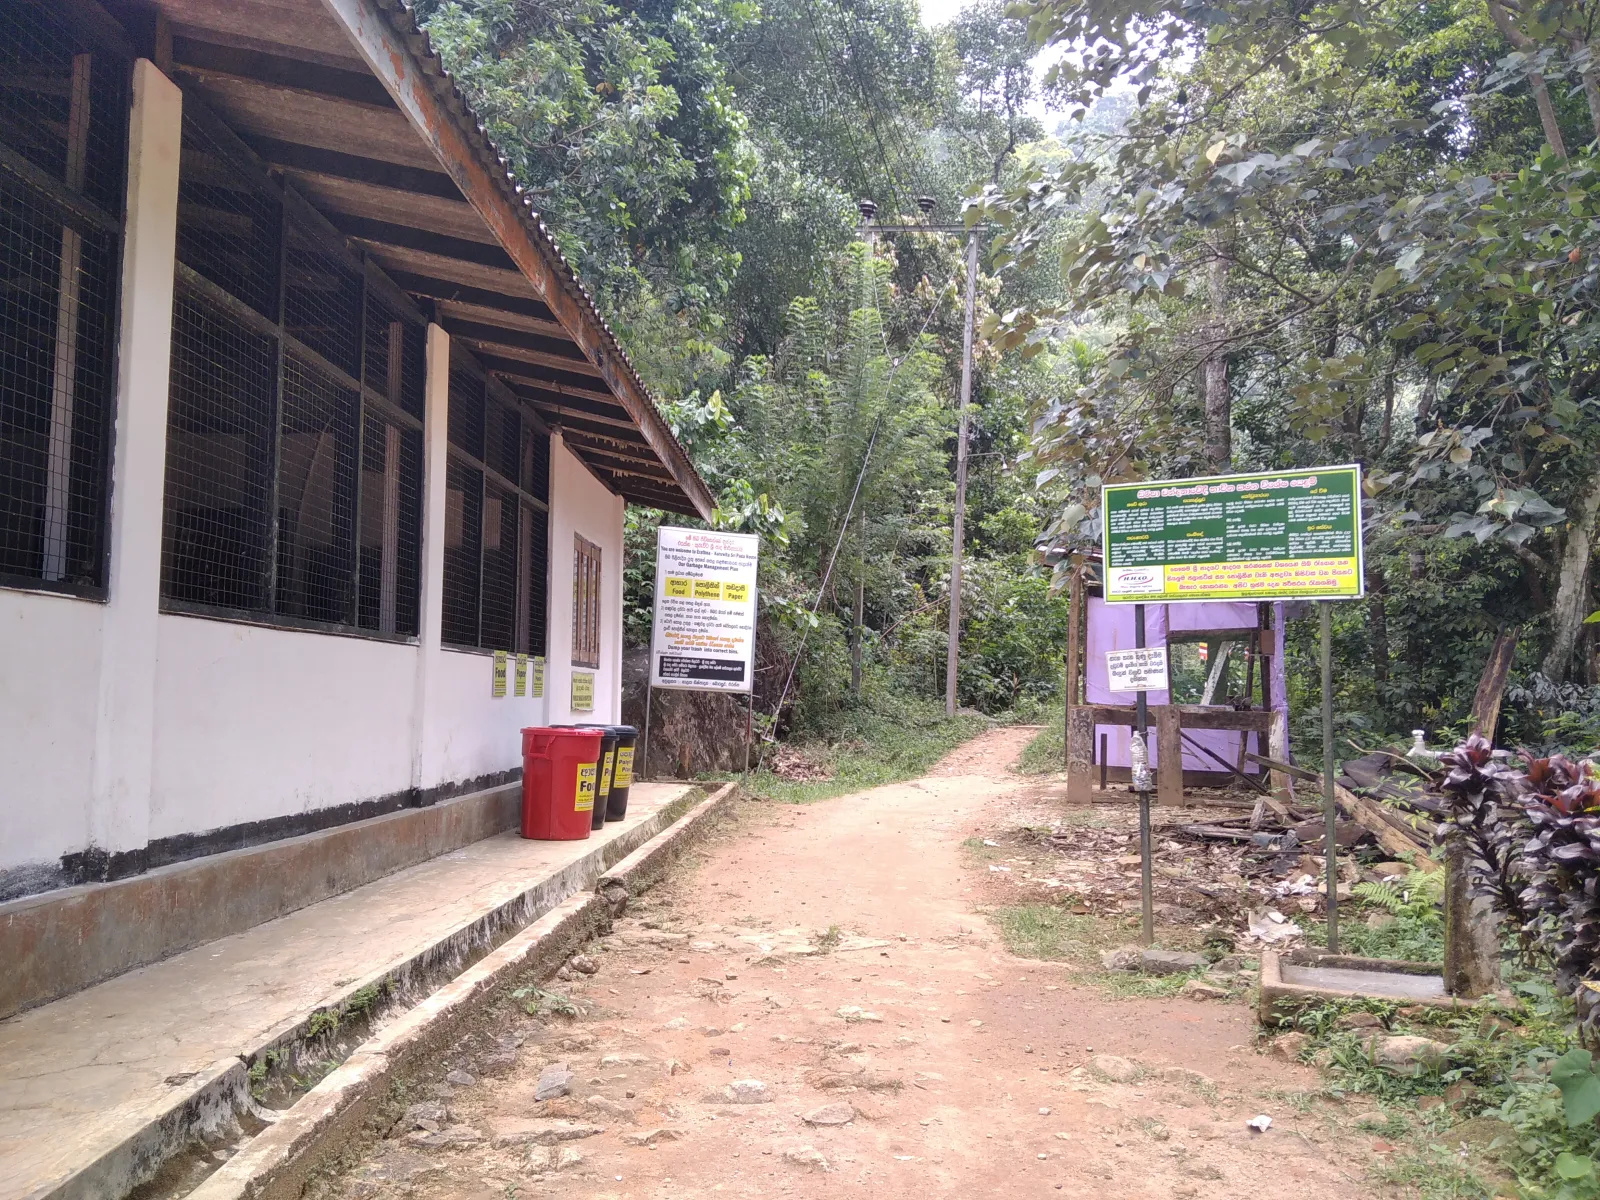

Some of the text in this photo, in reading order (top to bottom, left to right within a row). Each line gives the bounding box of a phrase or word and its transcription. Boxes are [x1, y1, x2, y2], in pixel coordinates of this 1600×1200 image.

[1237, 482, 1259, 491] කරන
[1260, 479, 1288, 490] විශේෂ
[695, 590, 720, 598] Polythene
[496, 667, 506, 678] Food
[517, 669, 526, 679] Paper
